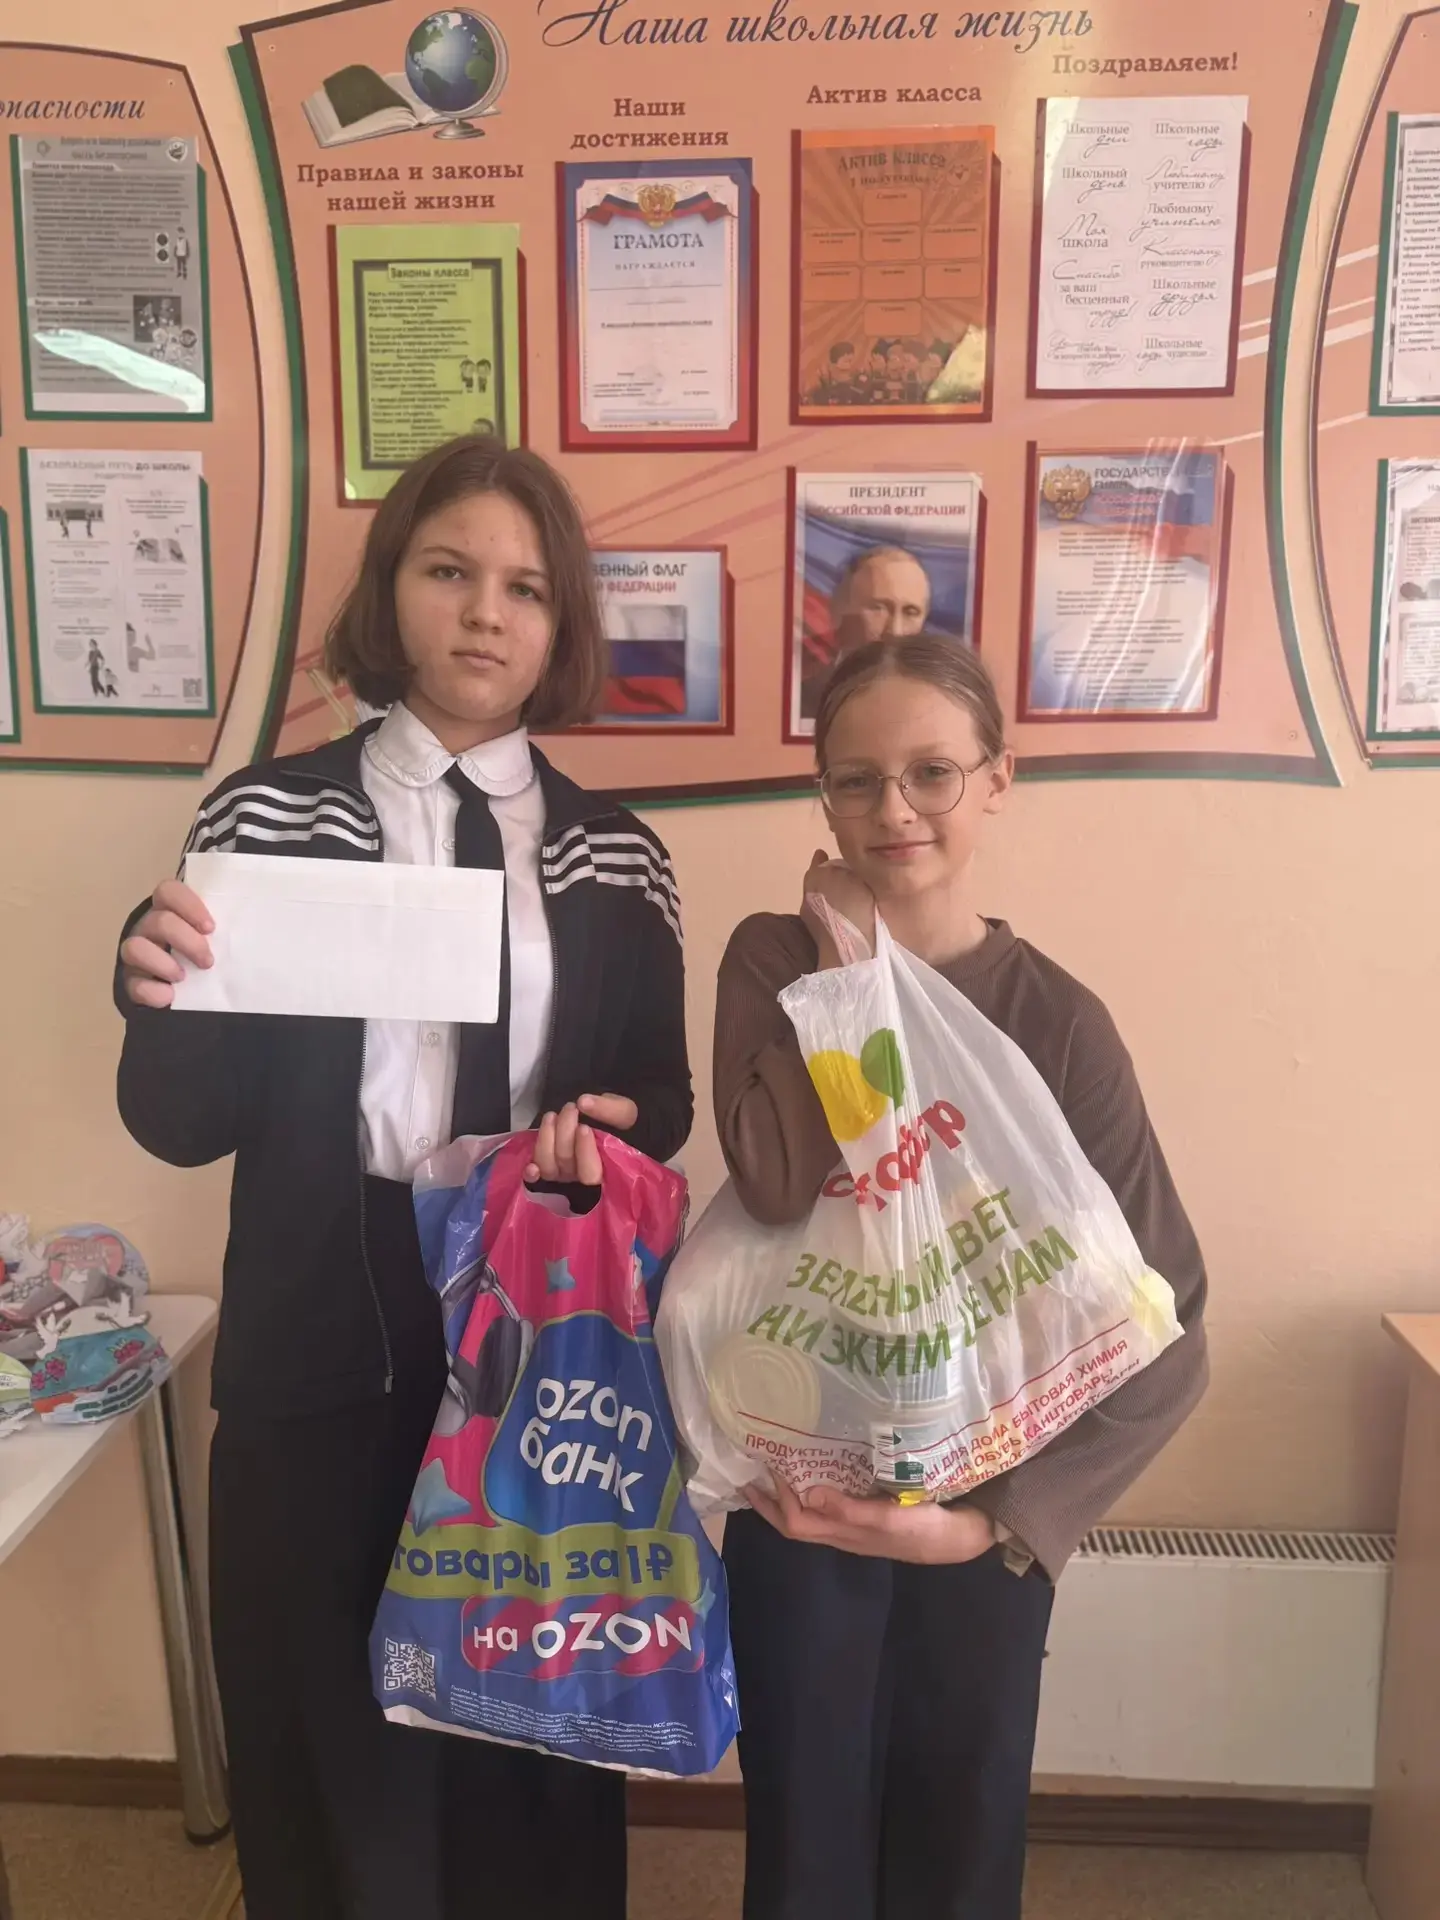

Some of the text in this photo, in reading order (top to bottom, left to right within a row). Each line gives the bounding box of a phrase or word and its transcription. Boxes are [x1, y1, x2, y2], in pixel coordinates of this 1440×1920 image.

[537, 0, 1094, 54] Наша школьная жизнь
[1052, 52, 1239, 78] Поздравляем!
[806, 84, 982, 104] Актив класса
[613, 98, 686, 117] Наши
[1067, 123, 1130, 135] Школьные
[1155, 122, 1220, 135] Школьные
[570, 130, 729, 149] достижения
[297, 164, 524, 187] Правила и законы
[1062, 166, 1127, 179] Школьный
[327, 190, 495, 211] нашей жизни
[613, 232, 704, 250] ГРАМОТА
[1062, 237, 1109, 248] школа
[1152, 277, 1217, 290] Школьные
[849, 486, 927, 499] ПРЕЗИДЕНТ
[894, 505, 966, 516] ФЕДЕРАЦИИ
[652, 563, 688, 577] ФЛАГ
[607, 581, 677, 593] ФЕДЕРАЦИИ
[946, 1187, 1020, 1275] ВЕТ
[747, 1303, 952, 1378] НИЗКИМ
[745, 1433, 834, 1458] ПРОДУКТЫ
[941, 1445, 969, 1471] ДЛЯ
[1011, 1372, 1076, 1429] БЫТОВАЯ
[1076, 1339, 1128, 1379] ХИМИЯ
[519, 1416, 644, 1513] банк
[565, 1549, 620, 1580] за
[473, 1612, 693, 1659] на OZON
